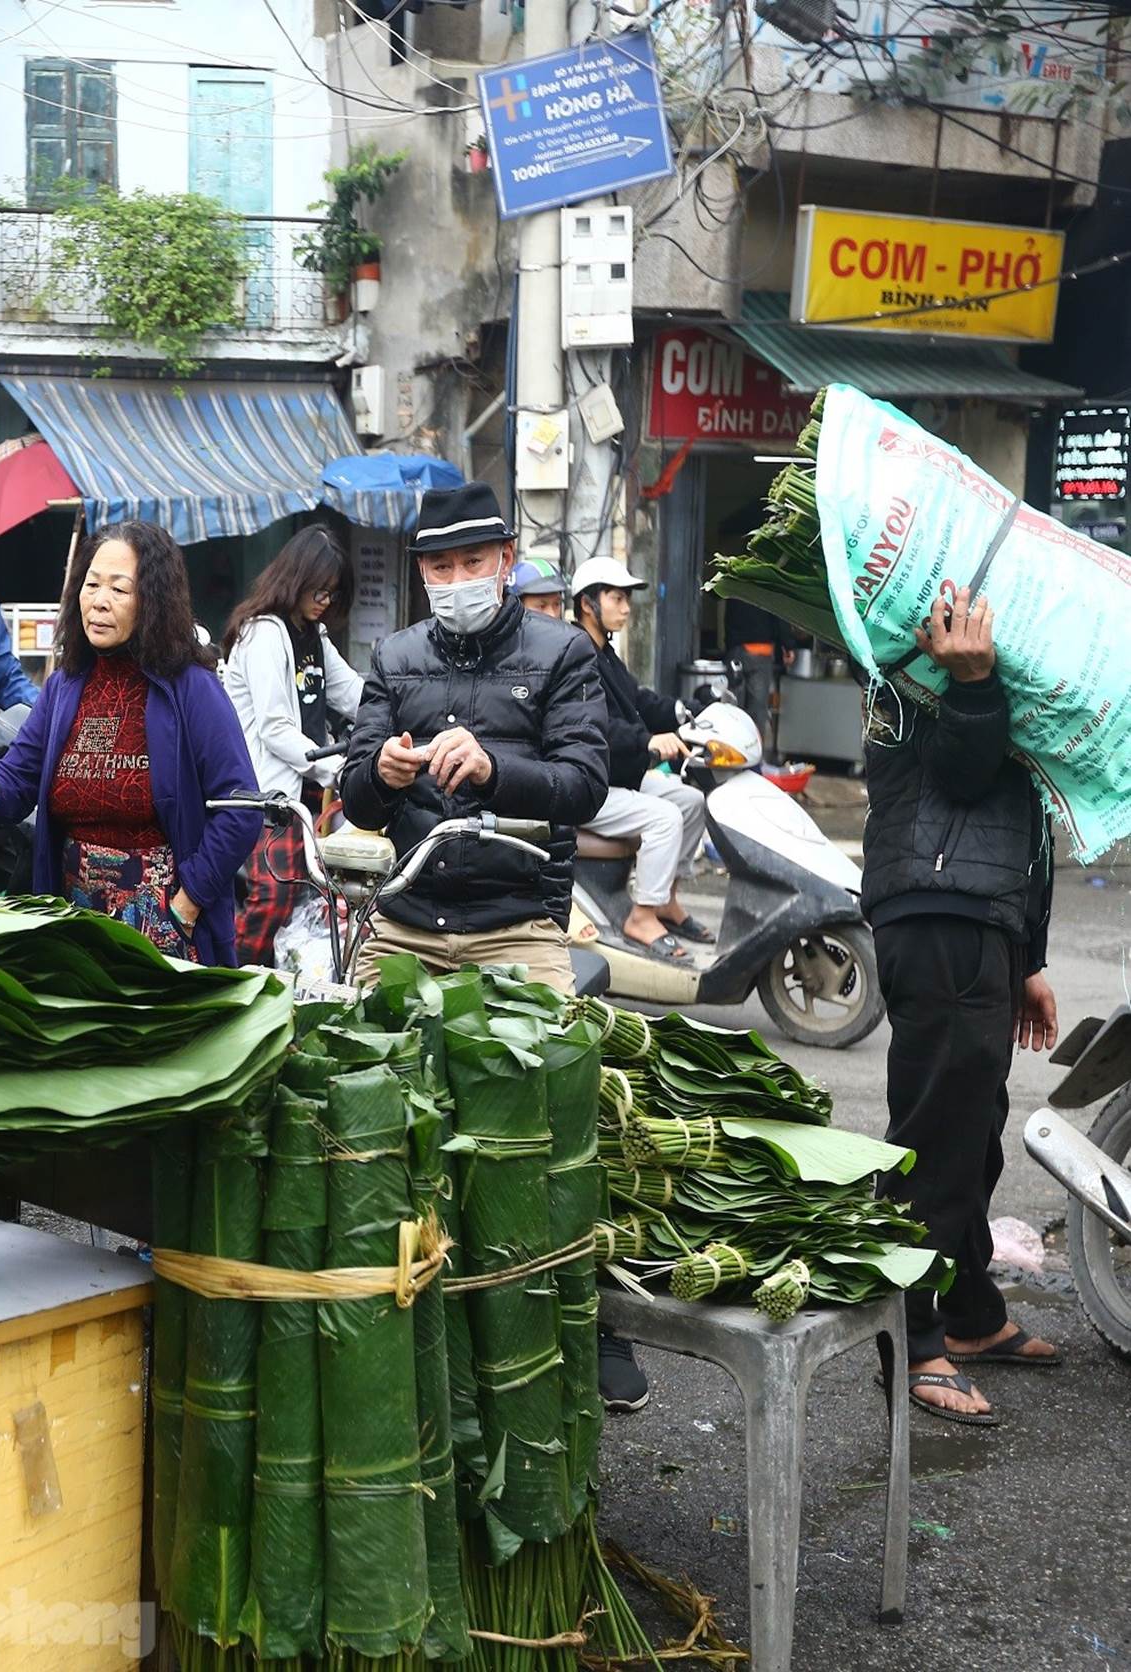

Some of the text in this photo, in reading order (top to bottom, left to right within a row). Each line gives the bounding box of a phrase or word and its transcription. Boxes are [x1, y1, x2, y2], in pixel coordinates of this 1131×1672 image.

[545, 80, 635, 121] HỒNG HÀ
[829, 236, 927, 283] CƠM
[959, 237, 1043, 290] PHỞ
[881, 284, 934, 308] BÌNH
[662, 338, 743, 397] CƠM
